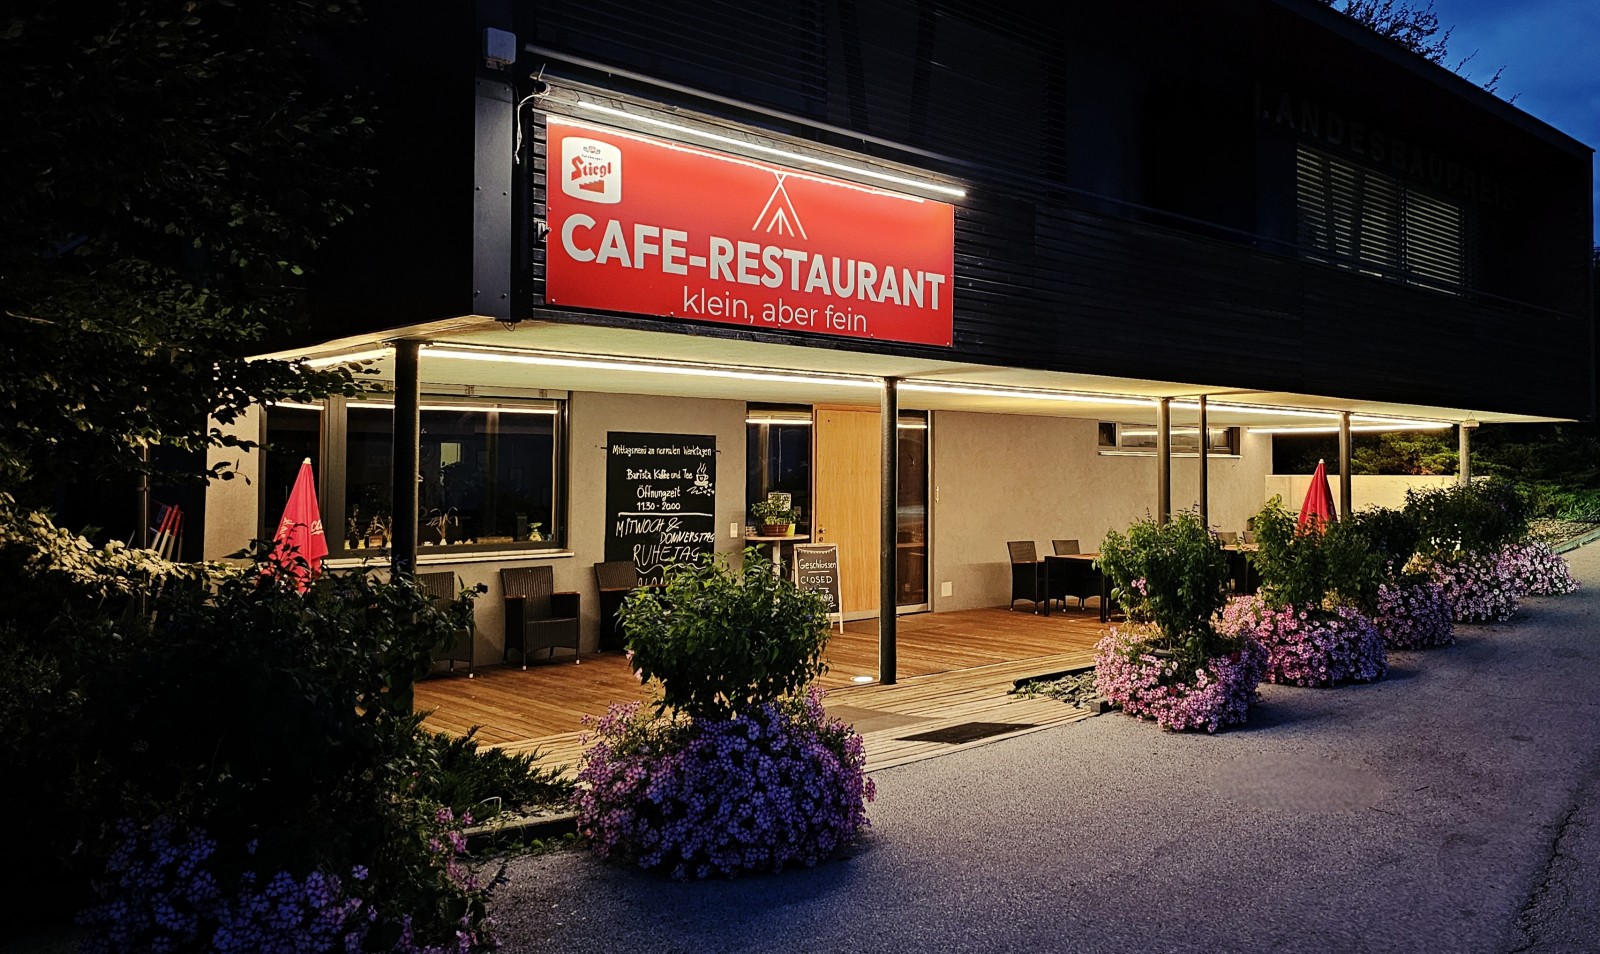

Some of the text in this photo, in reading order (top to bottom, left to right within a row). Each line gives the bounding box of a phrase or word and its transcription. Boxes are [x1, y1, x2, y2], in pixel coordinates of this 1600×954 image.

[571, 155, 611, 181] Stiegl
[561, 212, 946, 311] CAFE-RESTAURANT
[683, 285, 867, 333] klein, aber fein
[648, 446, 655, 455] an
[656, 444, 681, 455] normalen
[683, 445, 712, 458] Werktagen
[626, 468, 693, 480] Barista Kaffee und Tee
[636, 484, 681, 501] Öffnungzeit
[665, 517, 683, 532] &
[798, 558, 837, 570] Geschlossen
